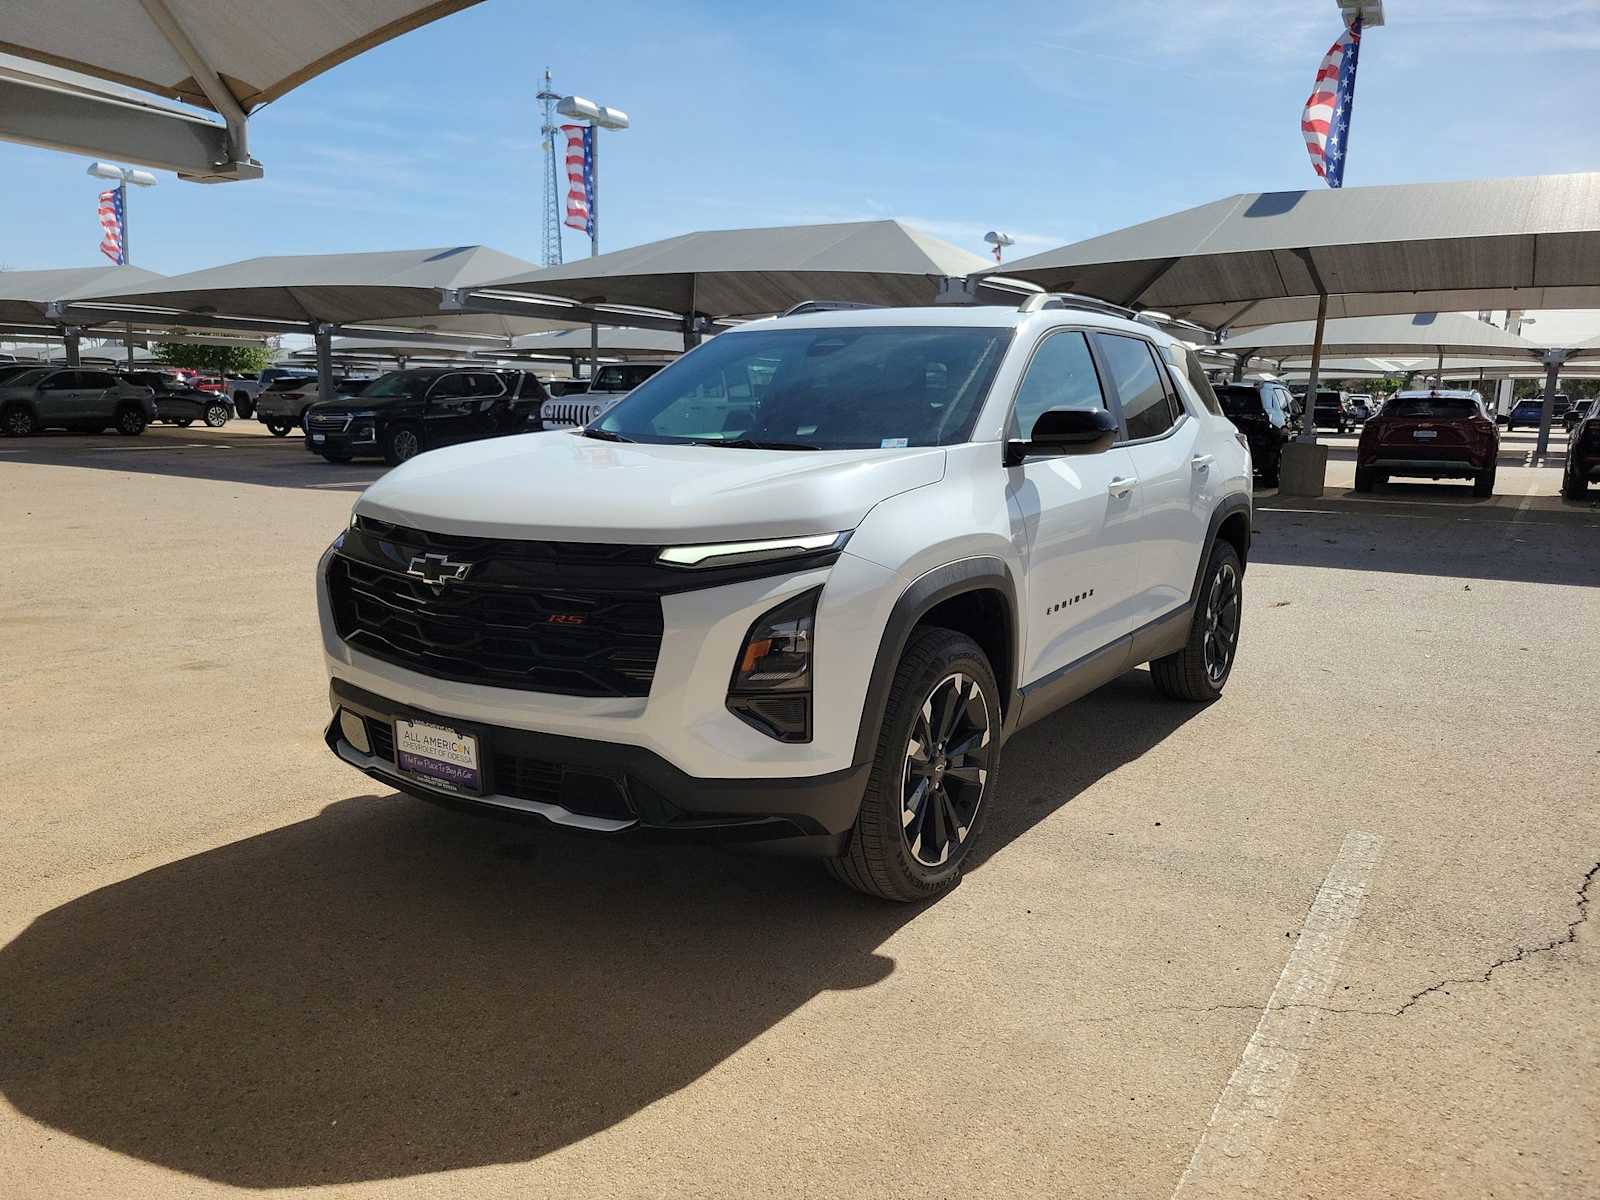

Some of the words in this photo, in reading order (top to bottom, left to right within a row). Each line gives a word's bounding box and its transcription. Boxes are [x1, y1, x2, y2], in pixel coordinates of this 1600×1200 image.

[1046, 588, 1094, 616] EQUINOX
[544, 614, 584, 625] RS
[404, 730, 421, 743] ALL
[402, 740, 437, 755] CHEVROLET
[437, 749, 446, 757] OF
[447, 752, 473, 764] ODESSA
